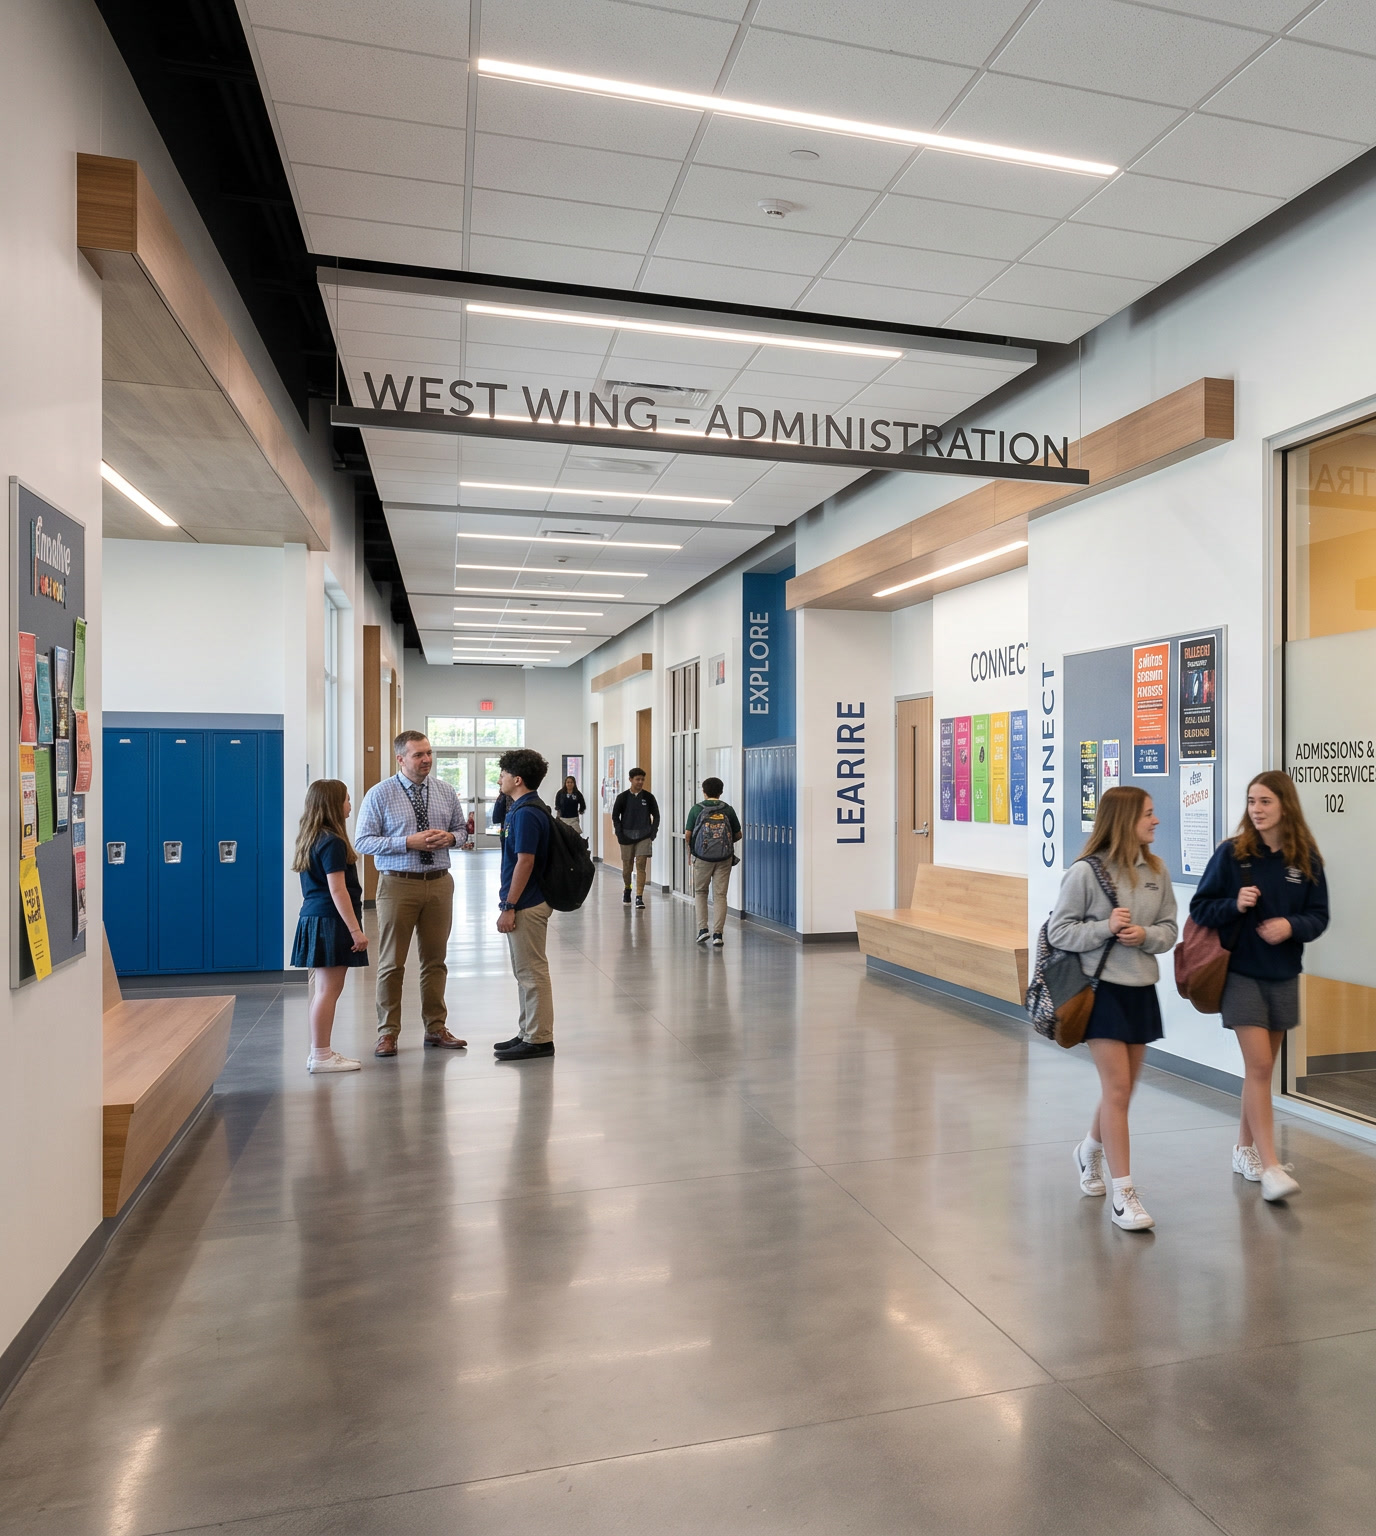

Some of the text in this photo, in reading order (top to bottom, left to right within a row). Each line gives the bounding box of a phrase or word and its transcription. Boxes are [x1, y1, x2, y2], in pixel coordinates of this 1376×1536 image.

[363, 371, 508, 418] WEST
[521, 386, 658, 432] WING
[704, 403, 1069, 467] ADMINISTRATION
[749, 612, 769, 715] EXPLORE
[970, 641, 1029, 683] CONNEC
[836, 701, 865, 844] LEARIRE
[1042, 662, 1055, 868] CONNECT
[1288, 766, 1330, 783] VISITOR
[1295, 740, 1375, 761] ADMISSIONS &
[1324, 793, 1345, 813] 102
